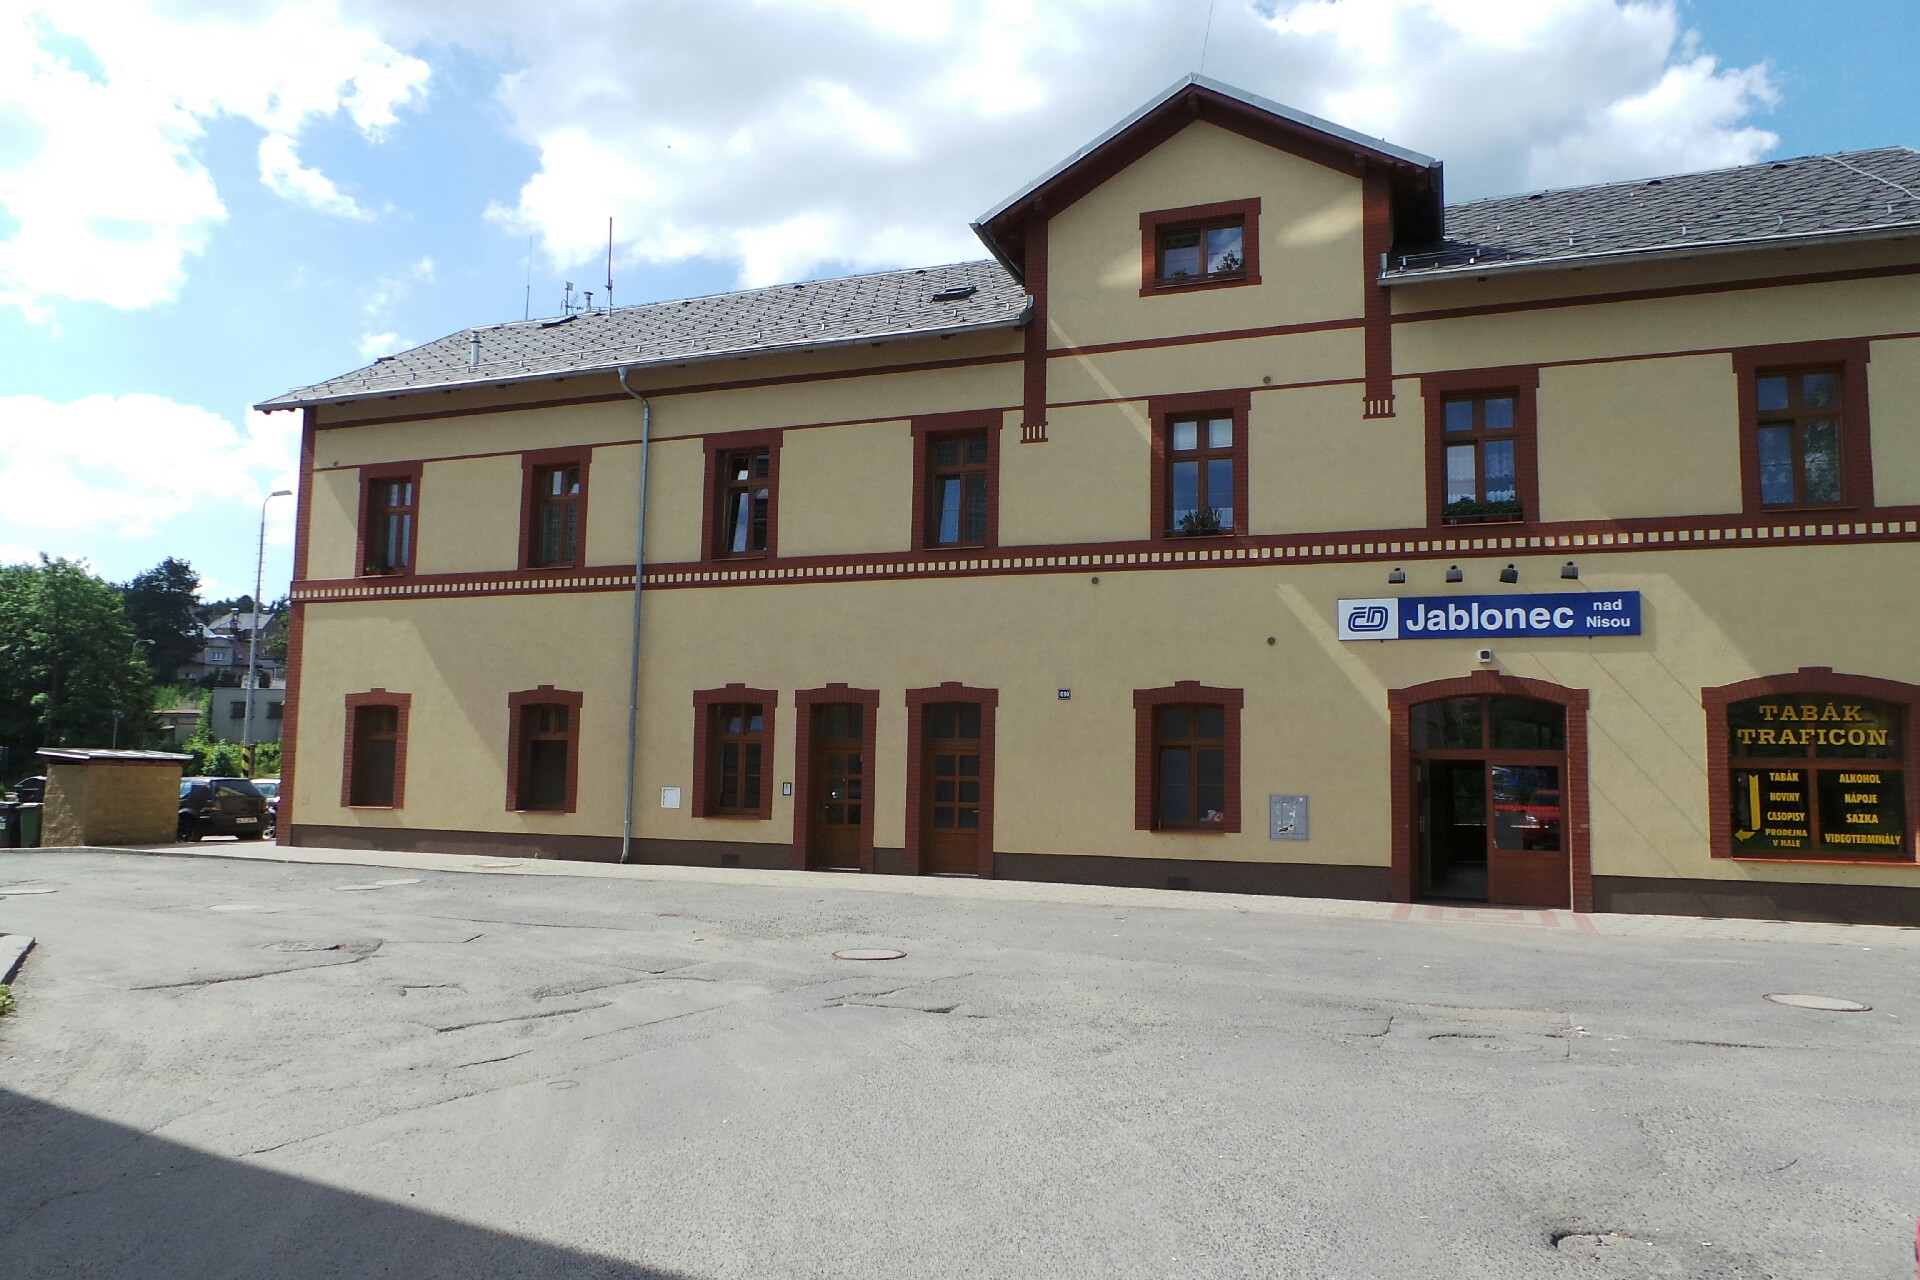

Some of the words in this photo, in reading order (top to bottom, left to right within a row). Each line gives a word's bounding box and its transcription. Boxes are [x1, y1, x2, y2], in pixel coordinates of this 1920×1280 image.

[1592, 598, 1623, 611] nad
[1406, 602, 1574, 631] Jablonec
[1586, 615, 1631, 628] Nisou
[1759, 702, 1862, 721] TABÁK
[1737, 729, 1888, 746] TRAFICON
[1769, 770, 1799, 782] TABÁK
[1839, 774, 1881, 783] ALKOHOL
[1770, 792, 1800, 802] NOVINY
[1844, 791, 1877, 803] NÁPOJE
[1846, 814, 1879, 823] SAZKA
[1765, 828, 1808, 837] PRODEJNA
[1824, 833, 1901, 845] VIDEOTERMINÁLY
